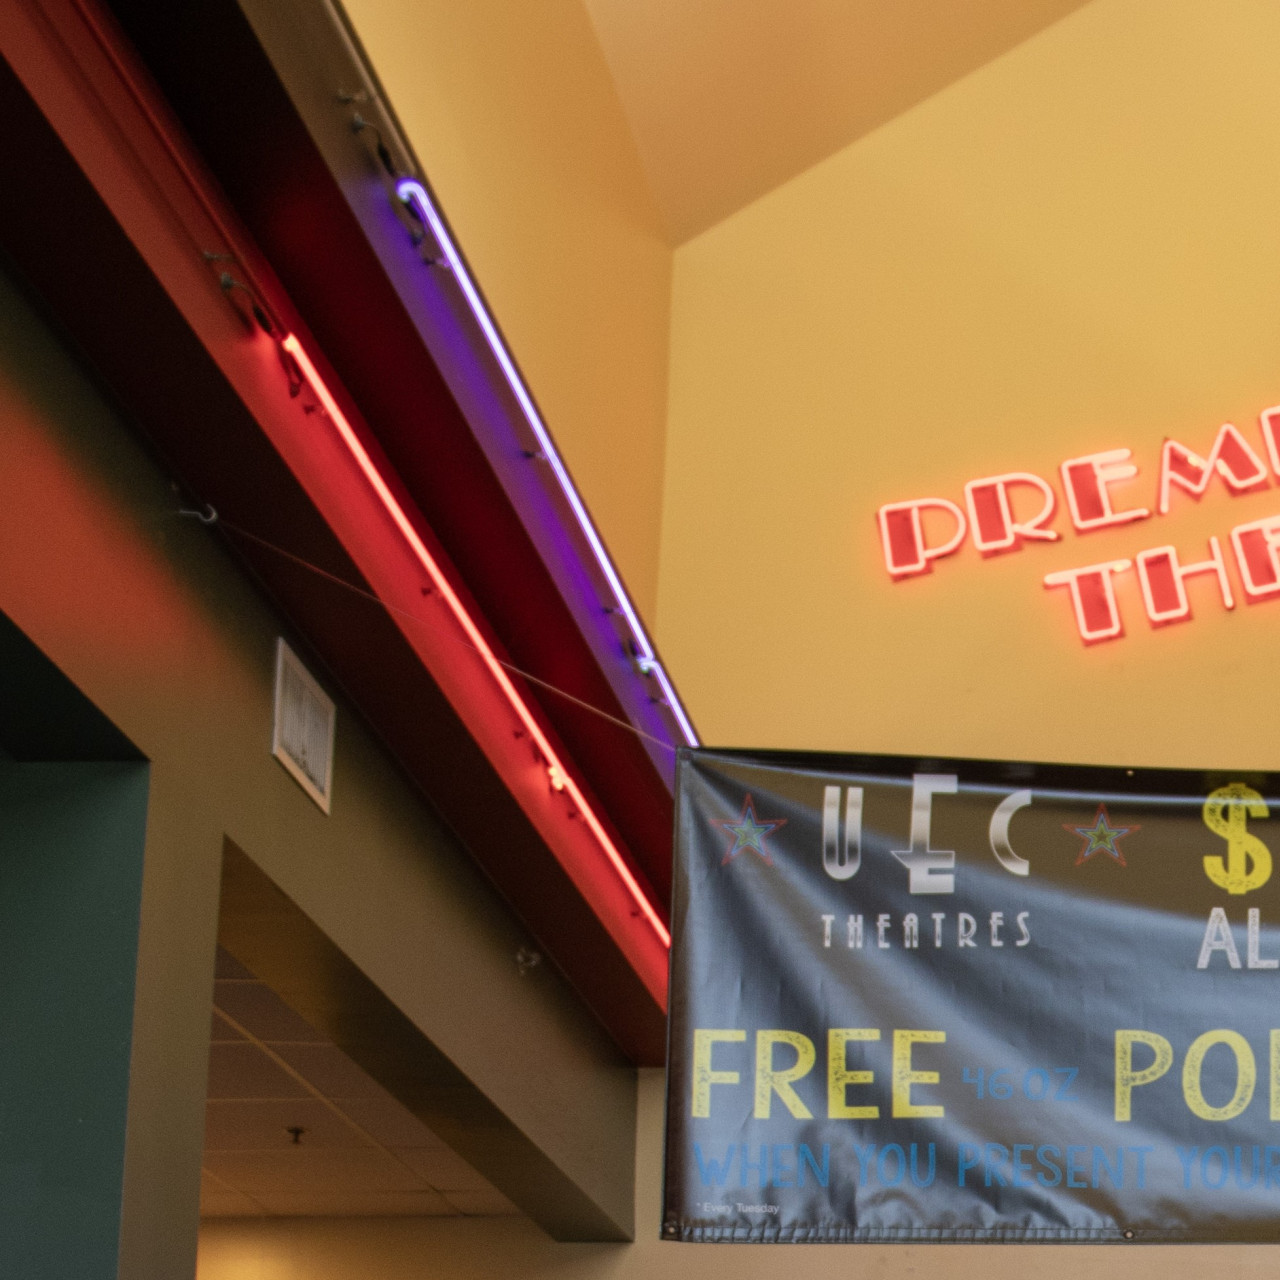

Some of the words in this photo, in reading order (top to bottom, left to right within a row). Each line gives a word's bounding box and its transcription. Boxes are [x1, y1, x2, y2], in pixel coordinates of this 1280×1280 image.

[821, 911, 1032, 950] THEATRES
[691, 1028, 947, 1119] FREE
[694, 1142, 831, 1189] WHEN
[854, 1142, 937, 1187] YOU
[957, 1143, 1153, 1191] PRESENT
[703, 1202, 732, 1214] Every
[735, 1202, 780, 1214] Tuesday
